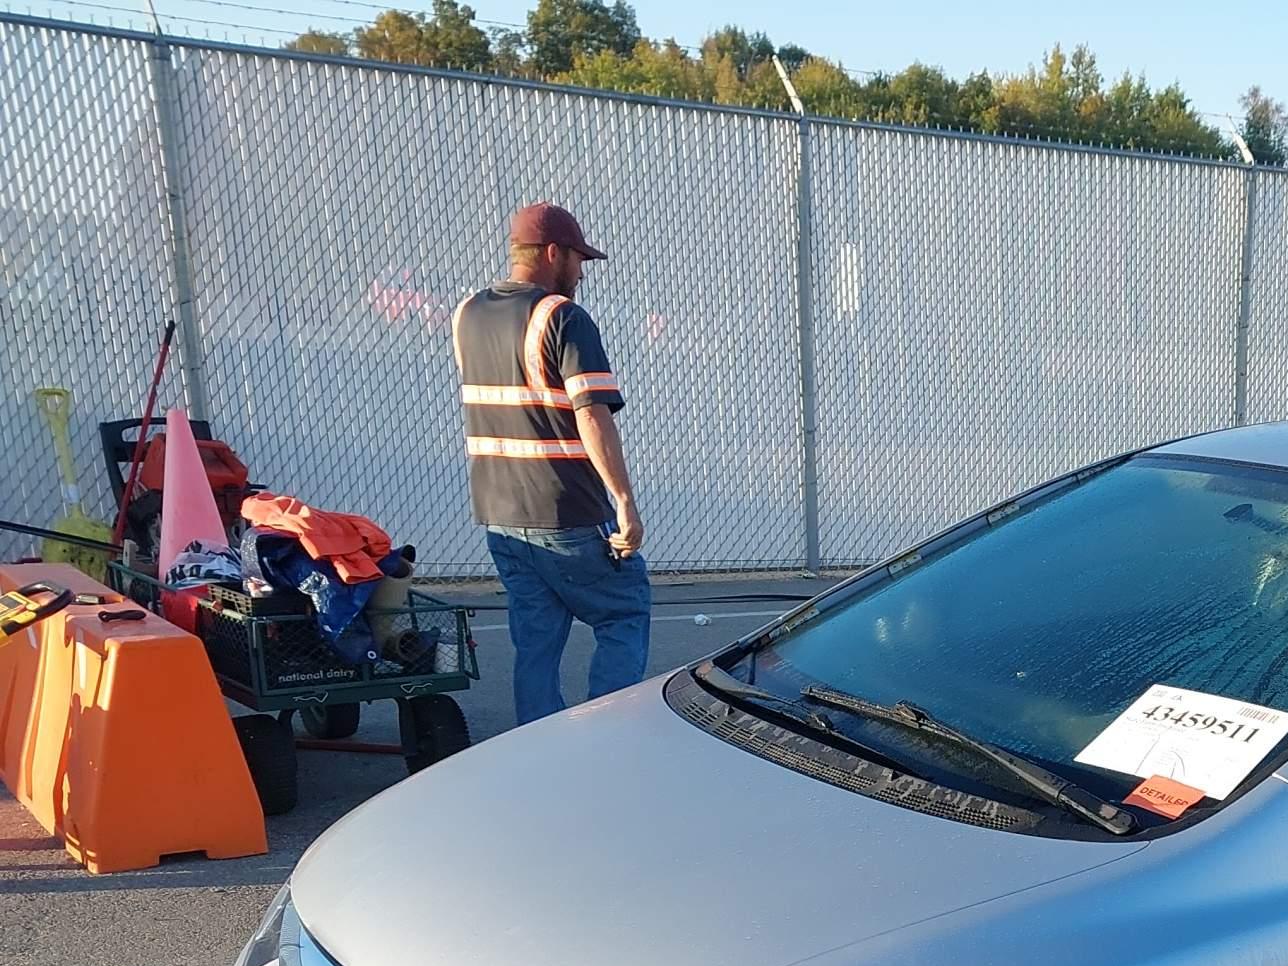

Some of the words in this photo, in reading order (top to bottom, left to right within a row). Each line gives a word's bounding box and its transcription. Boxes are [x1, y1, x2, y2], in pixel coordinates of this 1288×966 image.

[278, 670, 324, 683] national
[326, 668, 355, 679] dairy
[1142, 704, 1261, 744] 43459511
